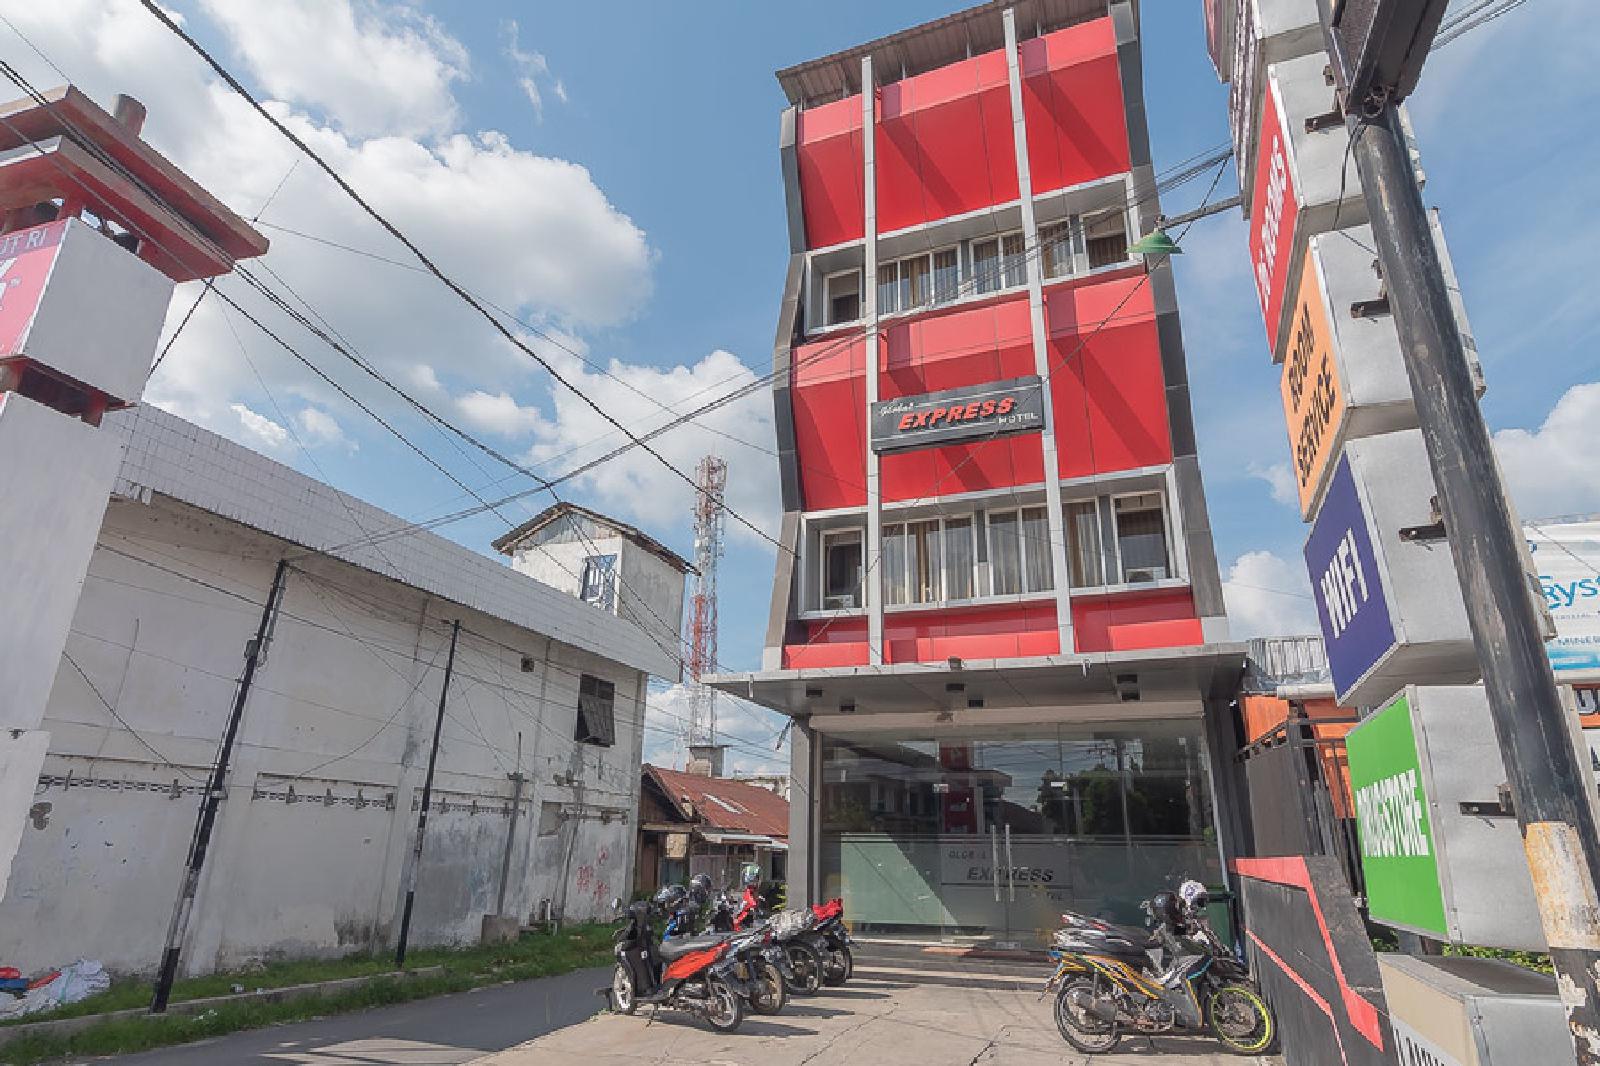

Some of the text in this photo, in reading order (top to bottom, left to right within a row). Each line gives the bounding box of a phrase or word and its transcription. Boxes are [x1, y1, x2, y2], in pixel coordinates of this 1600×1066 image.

[898, 397, 1016, 431] EXPRESS
[1289, 302, 1315, 414] ROOM
[998, 412, 1039, 424] HOTEL
[1297, 352, 1336, 488] SERVICE
[1320, 527, 1369, 639] WIFI
